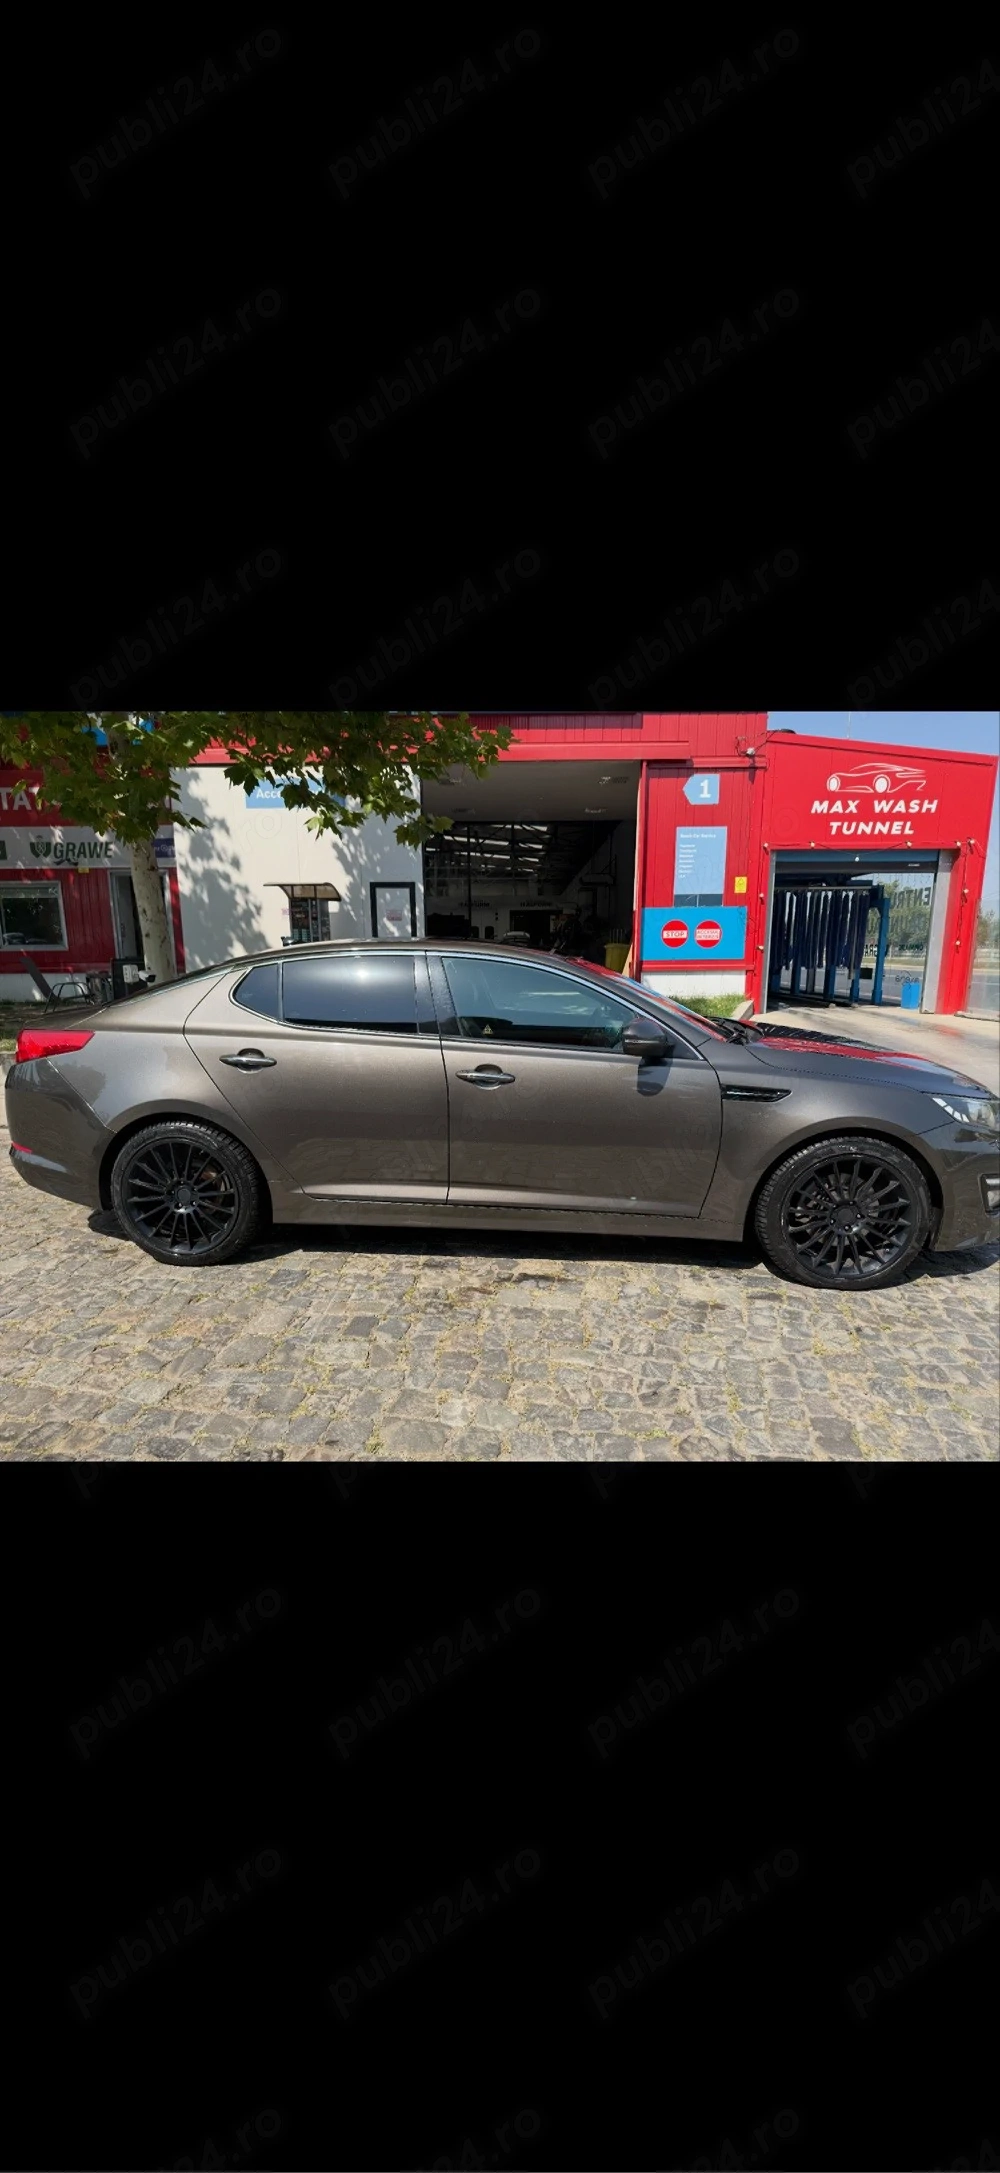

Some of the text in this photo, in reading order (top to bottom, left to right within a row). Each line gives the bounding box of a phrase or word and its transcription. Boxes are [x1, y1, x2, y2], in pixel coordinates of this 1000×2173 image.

[700, 779, 711, 798] 1
[811, 799, 938, 813] MAX WASH
[829, 821, 914, 835] TUNNEL
[54, 842, 113, 860] GRAWE
